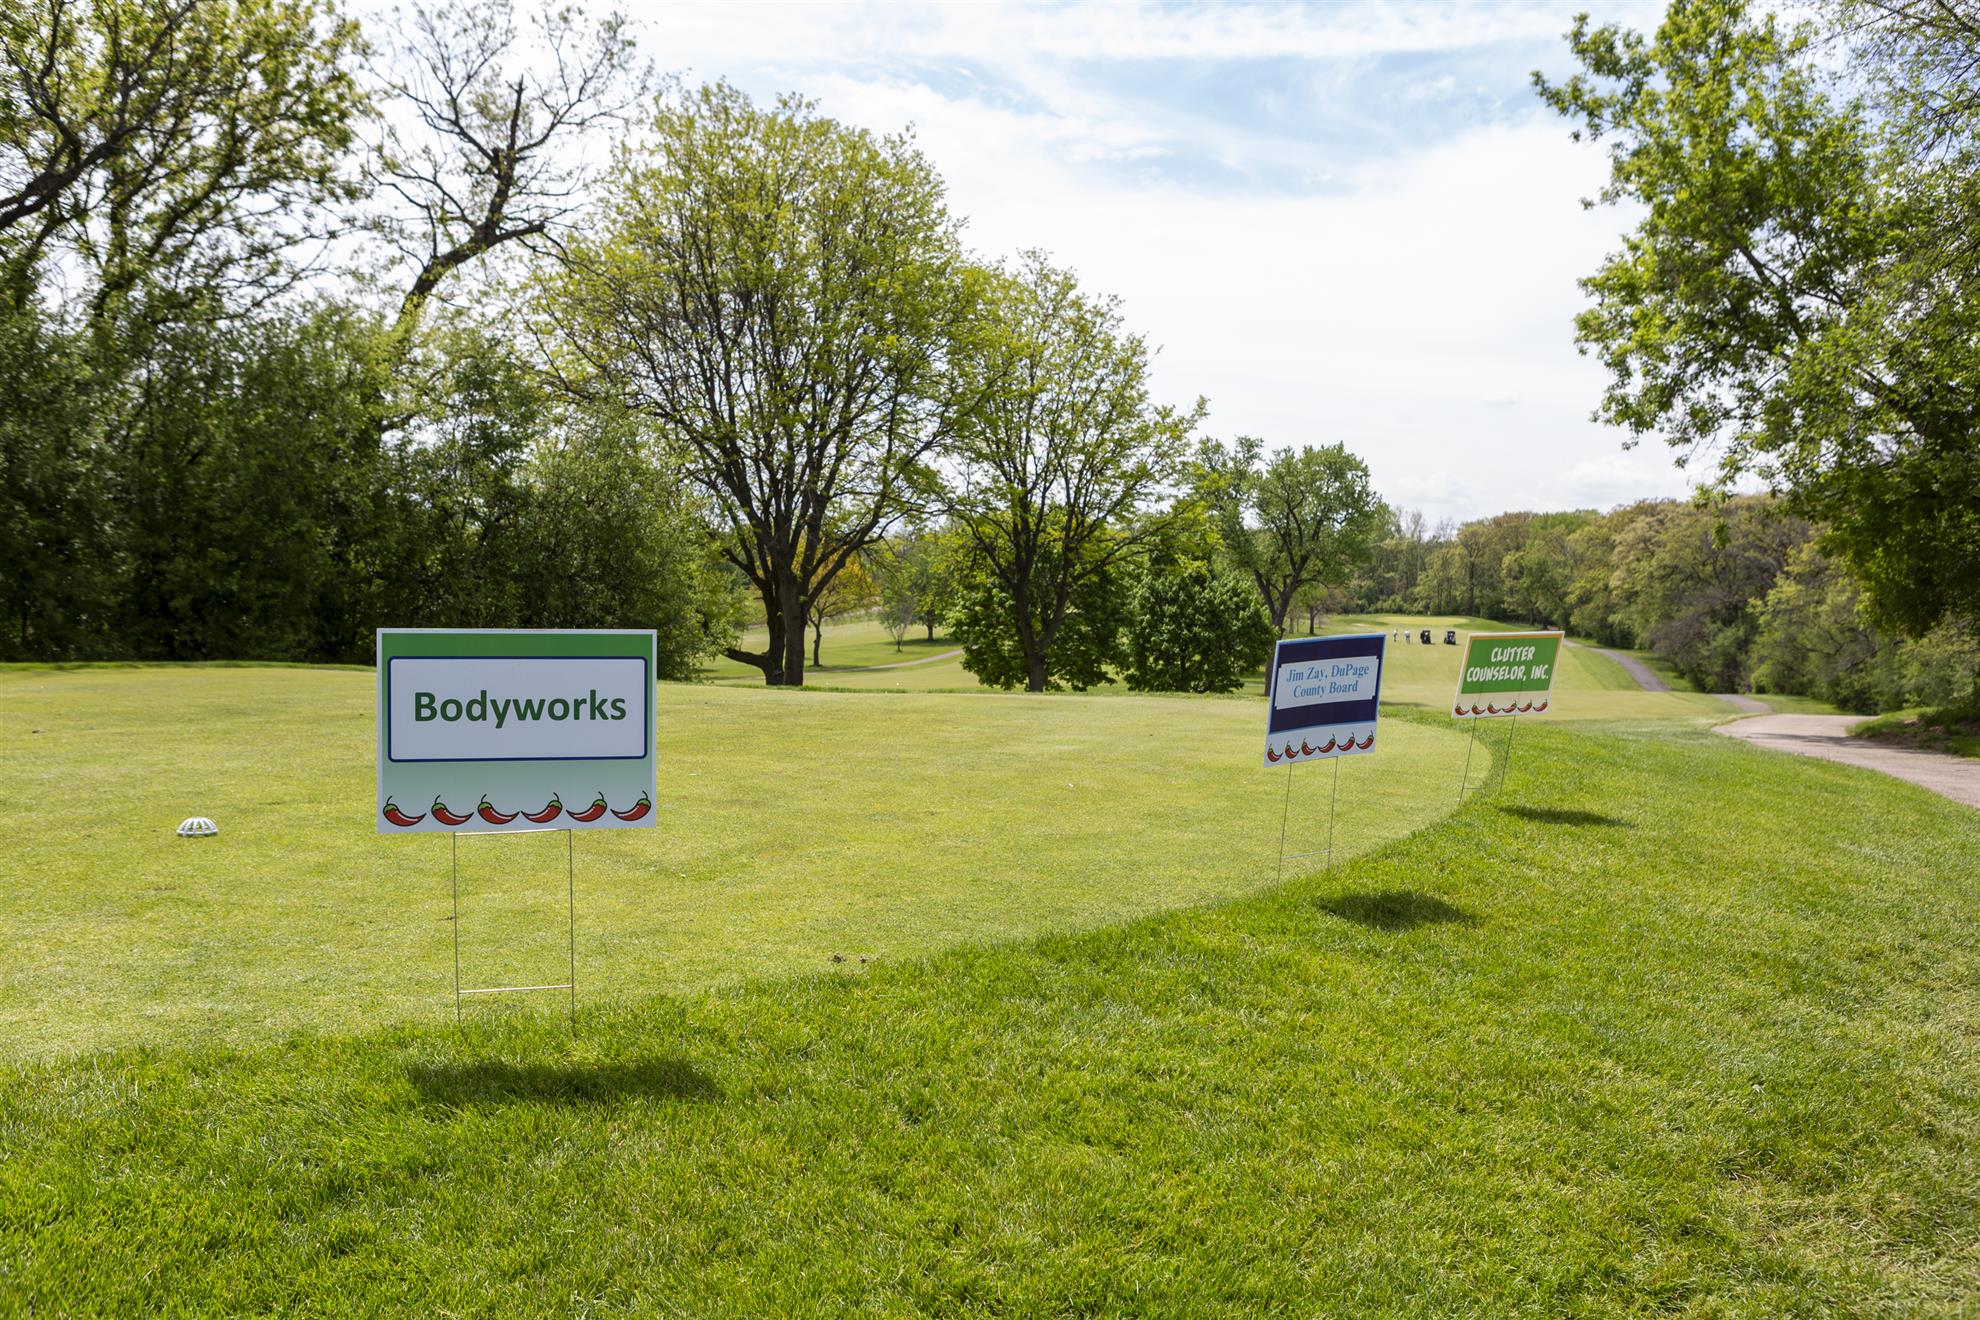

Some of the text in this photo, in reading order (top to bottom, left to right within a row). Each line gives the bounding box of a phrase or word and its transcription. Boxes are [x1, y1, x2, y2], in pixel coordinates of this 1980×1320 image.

[1491, 647, 1535, 662] CLUTTER
[1286, 664, 1369, 682] Jim Zay, DuPage
[1467, 665, 1549, 682] COUNSELOR, INC.
[1293, 680, 1358, 697] County Board
[414, 689, 627, 728] Bodyworks
